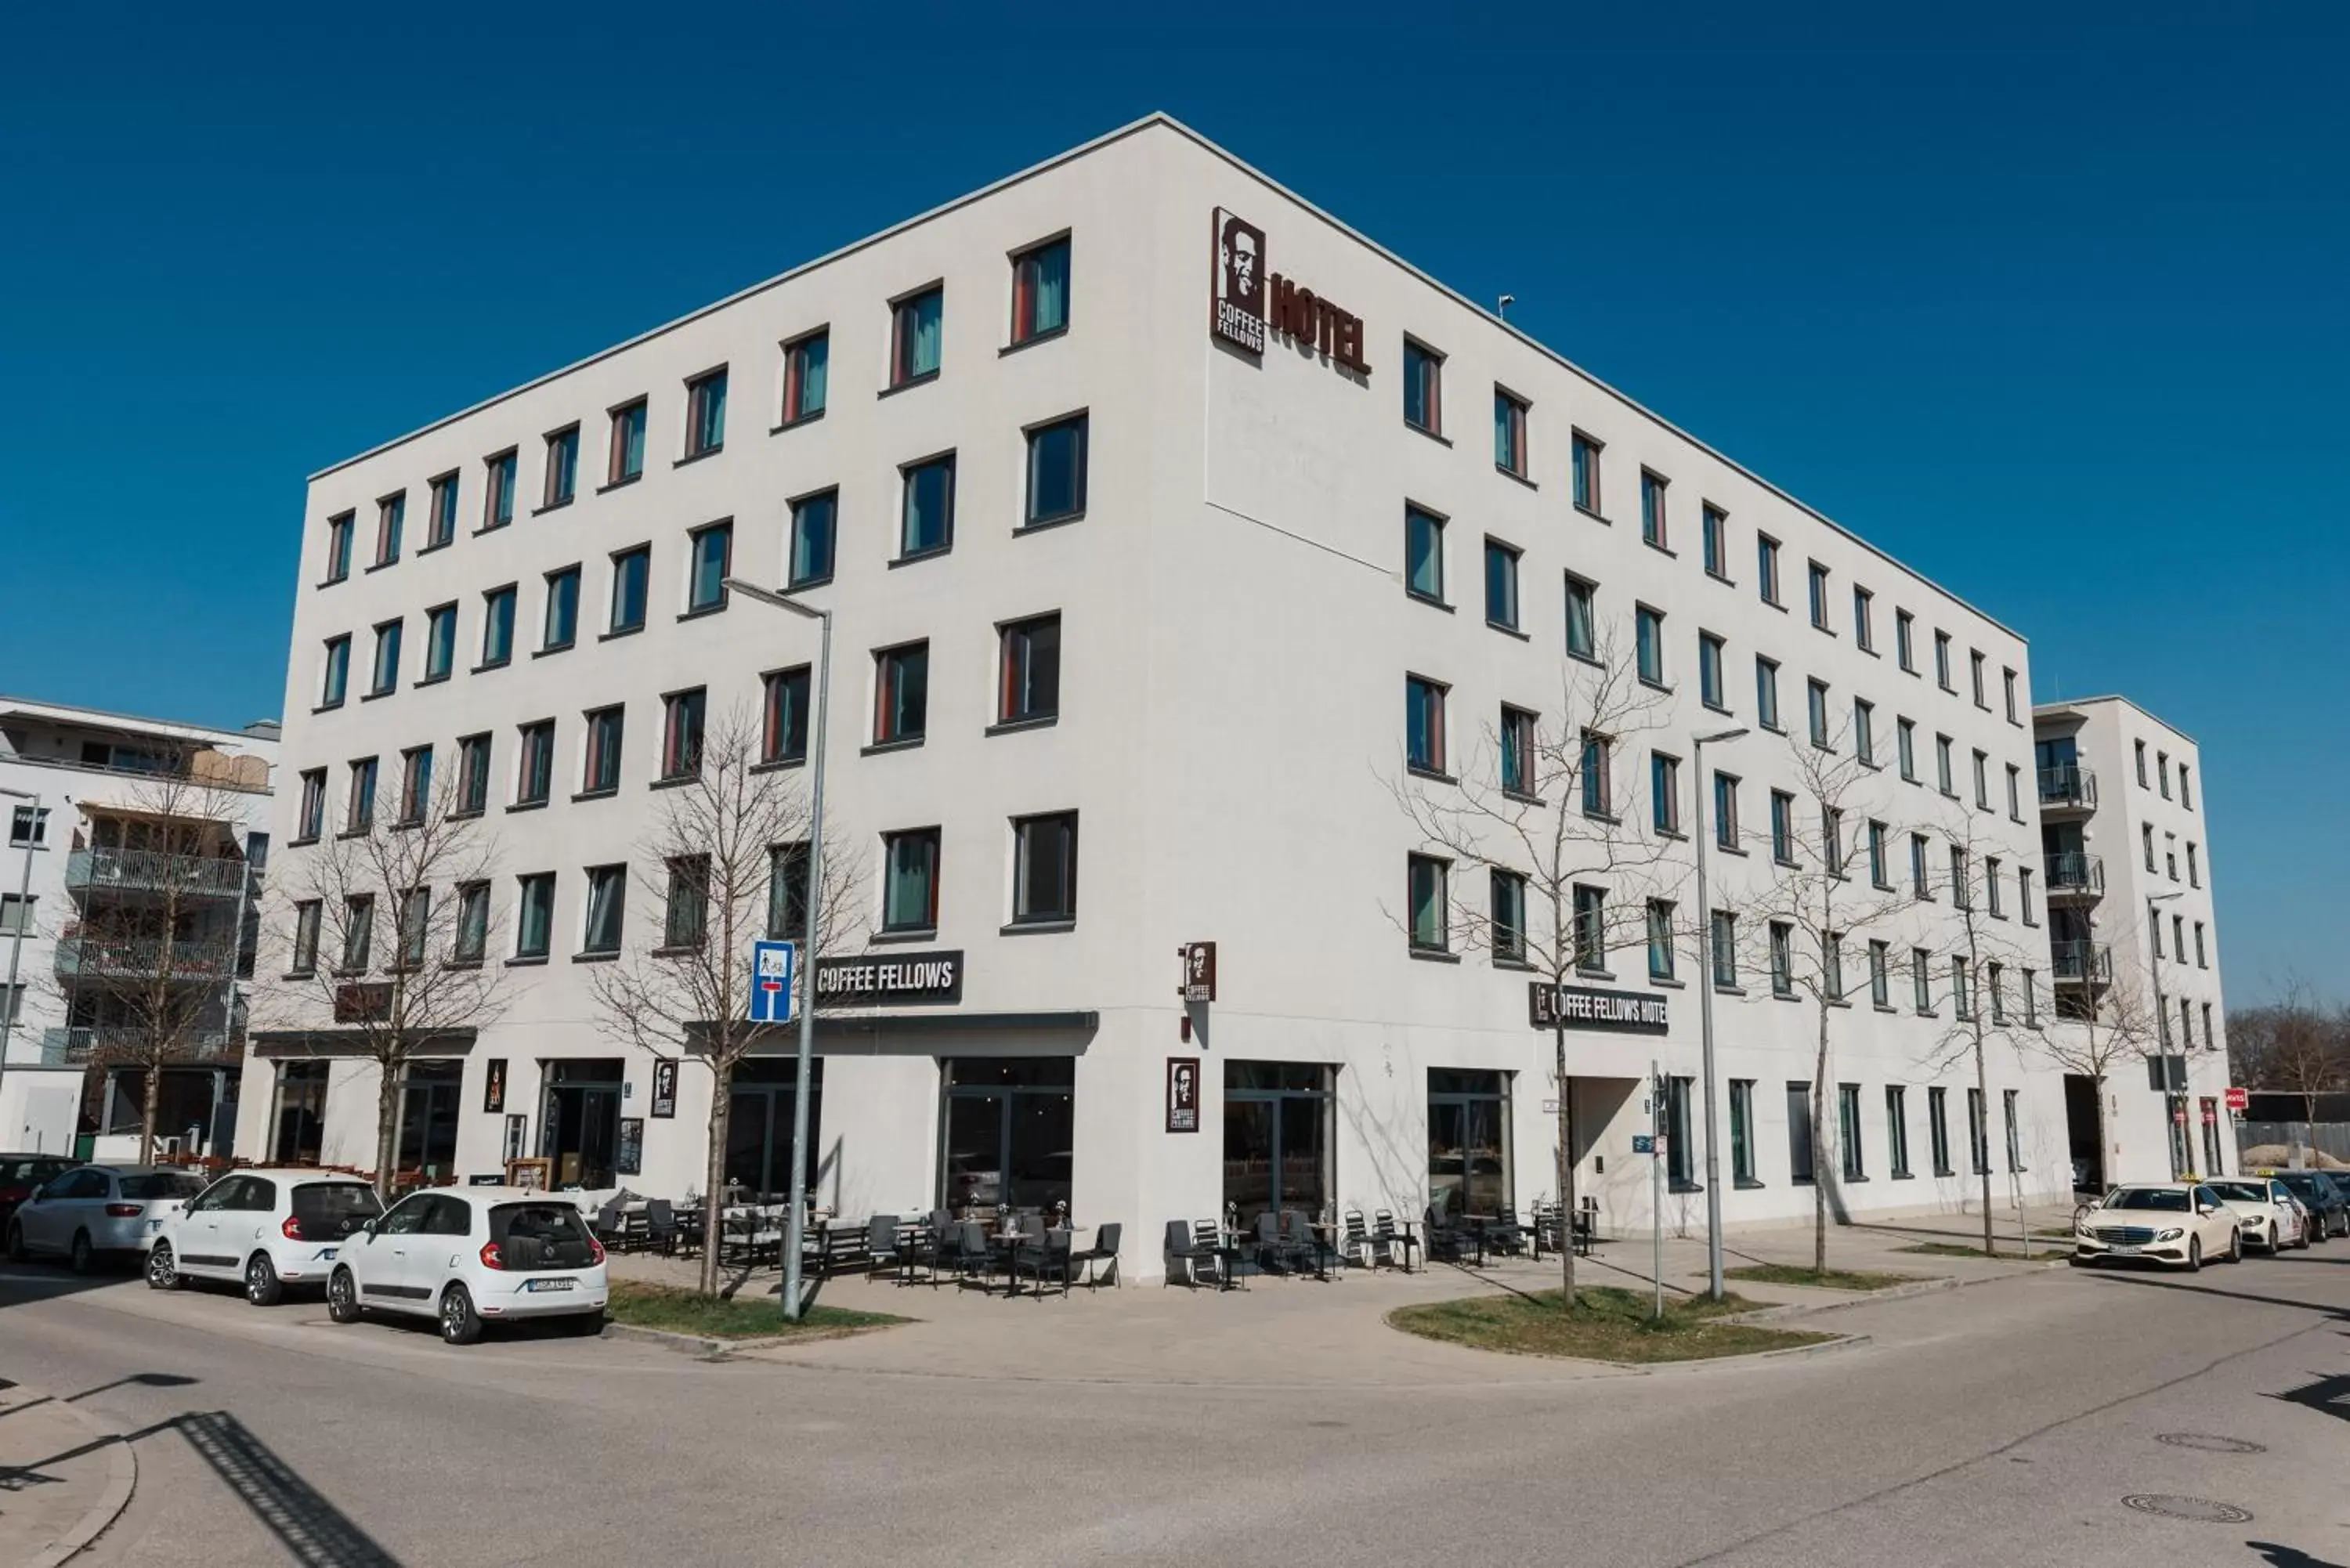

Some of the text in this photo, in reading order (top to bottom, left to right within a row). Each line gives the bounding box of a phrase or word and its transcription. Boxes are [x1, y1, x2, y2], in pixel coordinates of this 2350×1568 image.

[1218, 300, 1263, 338] COFFEE
[1218, 318, 1263, 352] FELLOWS
[1271, 272, 1372, 374] HOTEL
[817, 961, 953, 992] COFFEE FELLOWS
[1594, 996, 1639, 1021] FELLOWS
